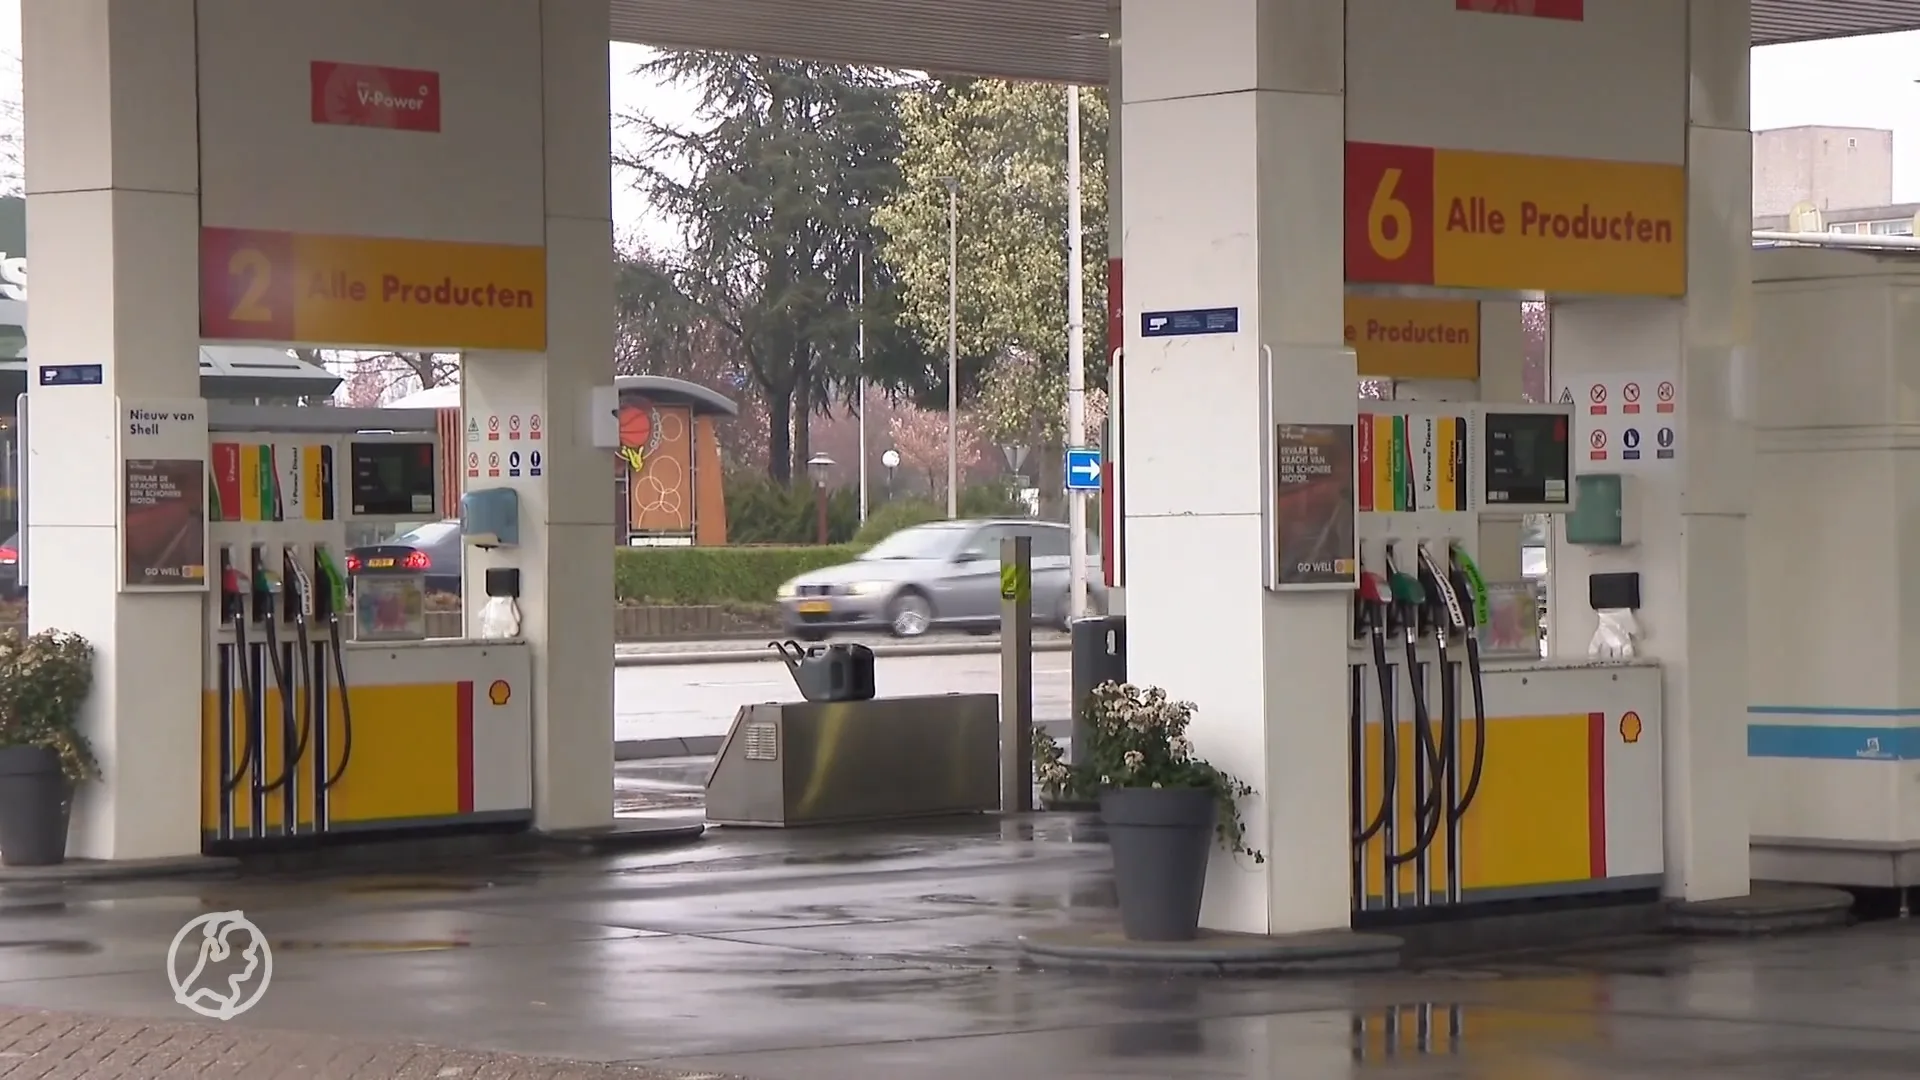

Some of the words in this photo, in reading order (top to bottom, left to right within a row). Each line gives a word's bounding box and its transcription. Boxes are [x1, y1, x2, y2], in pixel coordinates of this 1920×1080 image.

[357, 89, 424, 110] V-Power
[1367, 167, 1413, 261] 6
[1446, 196, 1506, 234] Alle
[1520, 201, 1673, 243] Producten
[227, 248, 273, 322] 2
[307, 270, 367, 302] Alle
[382, 274, 534, 309] Producten
[1366, 319, 1470, 344] Producten
[129, 409, 169, 421] Nieuw
[173, 411, 195, 421] van
[129, 424, 160, 435] Shell
[1281, 446, 1308, 455] ERVAAR
[1281, 455, 1309, 464] KRACHT
[1310, 455, 1326, 464] VAN
[1281, 464, 1295, 474] EEN
[144, 567, 159, 576] GO
[159, 567, 180, 576] WELL
[1297, 562, 1311, 572] GO
[1312, 562, 1333, 572] WELL
